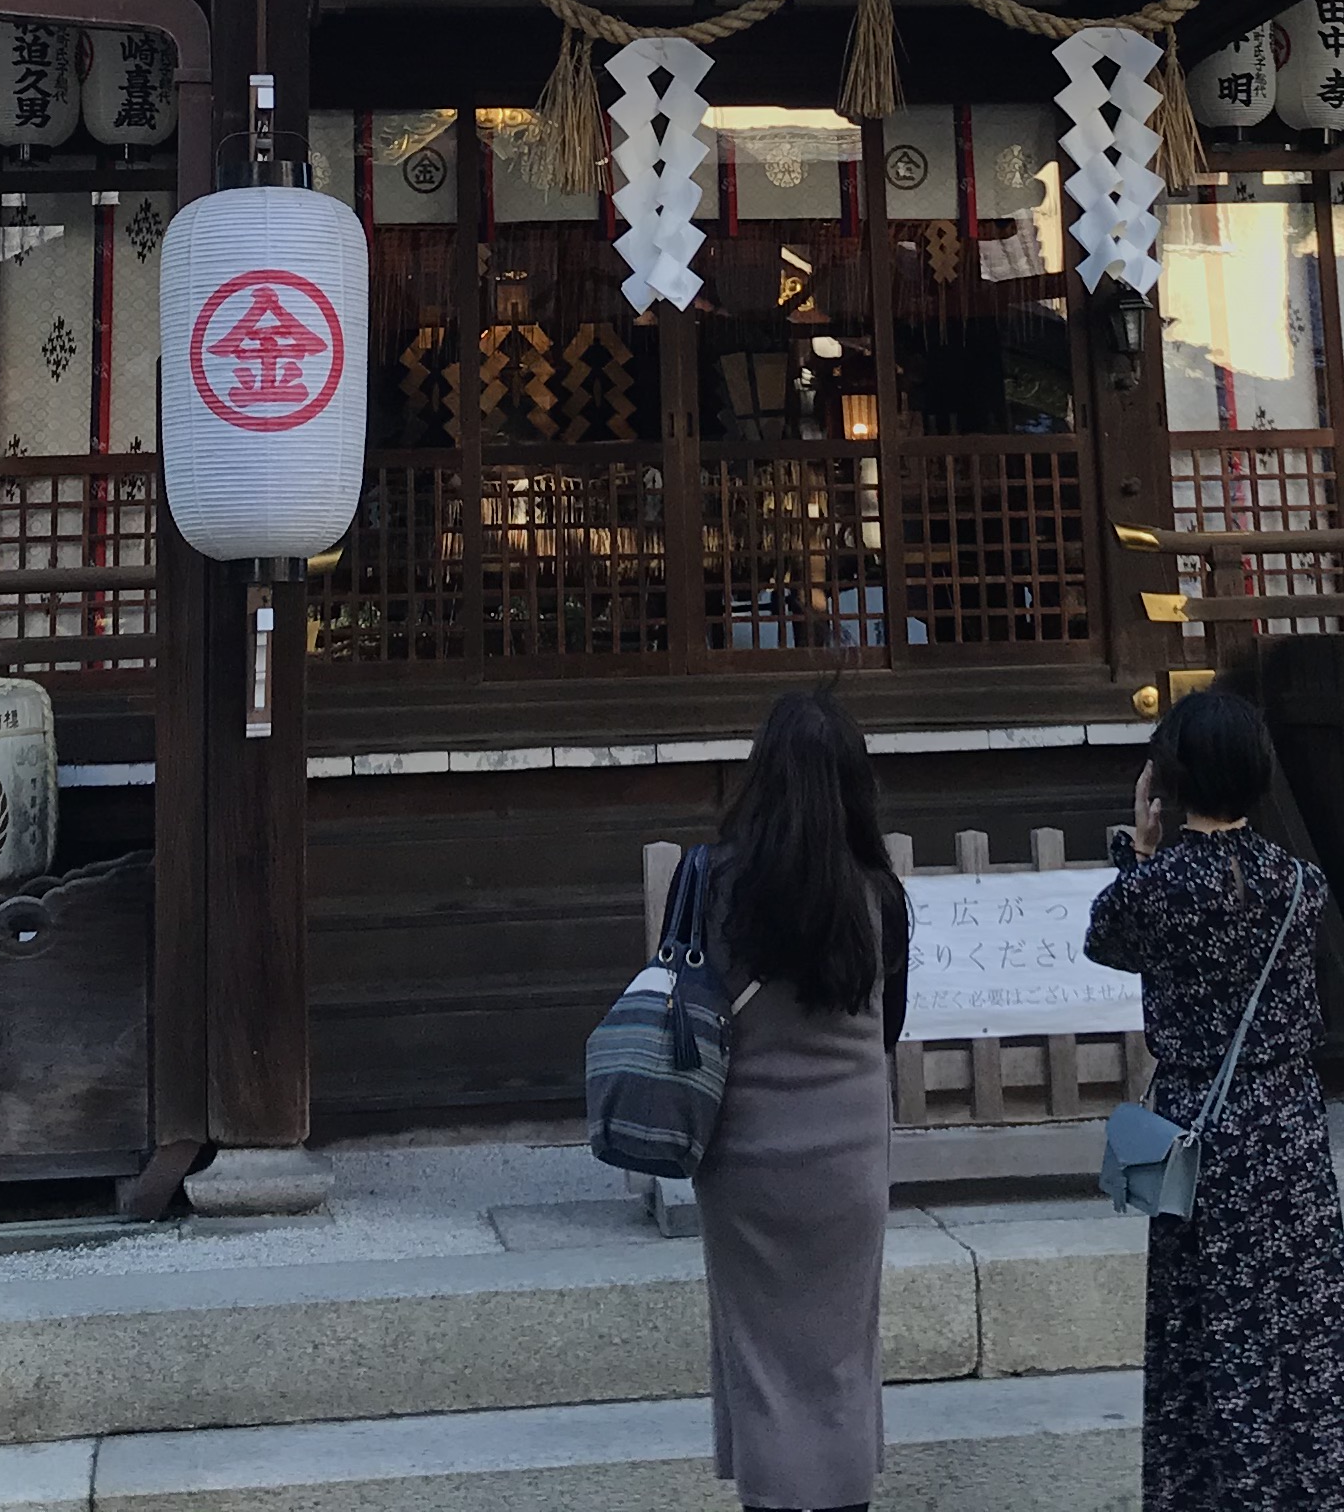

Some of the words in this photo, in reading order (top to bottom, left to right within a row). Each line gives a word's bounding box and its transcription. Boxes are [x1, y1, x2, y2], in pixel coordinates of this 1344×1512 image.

[411, 150, 441, 184] 金
[891, 150, 921, 184] 金
[207, 285, 328, 408] 金
